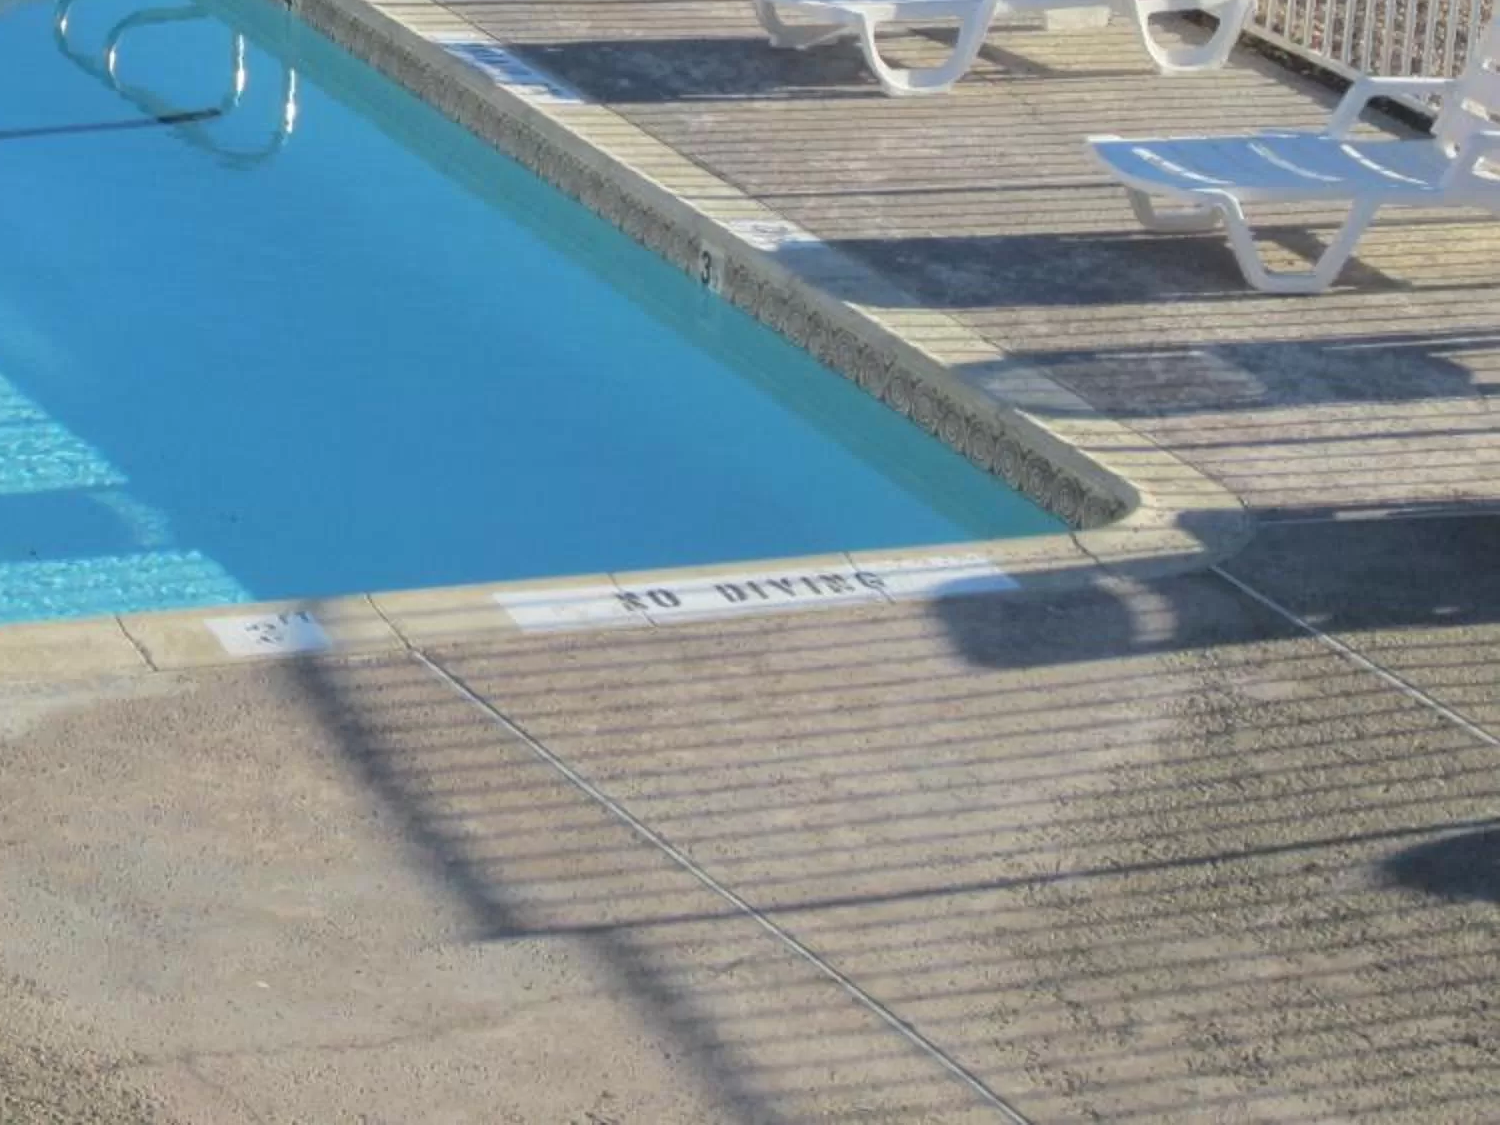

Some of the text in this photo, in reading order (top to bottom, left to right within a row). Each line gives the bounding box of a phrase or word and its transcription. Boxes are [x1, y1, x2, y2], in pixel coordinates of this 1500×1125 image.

[701, 249, 712, 285] 3
[615, 570, 887, 612] NO DIVING
